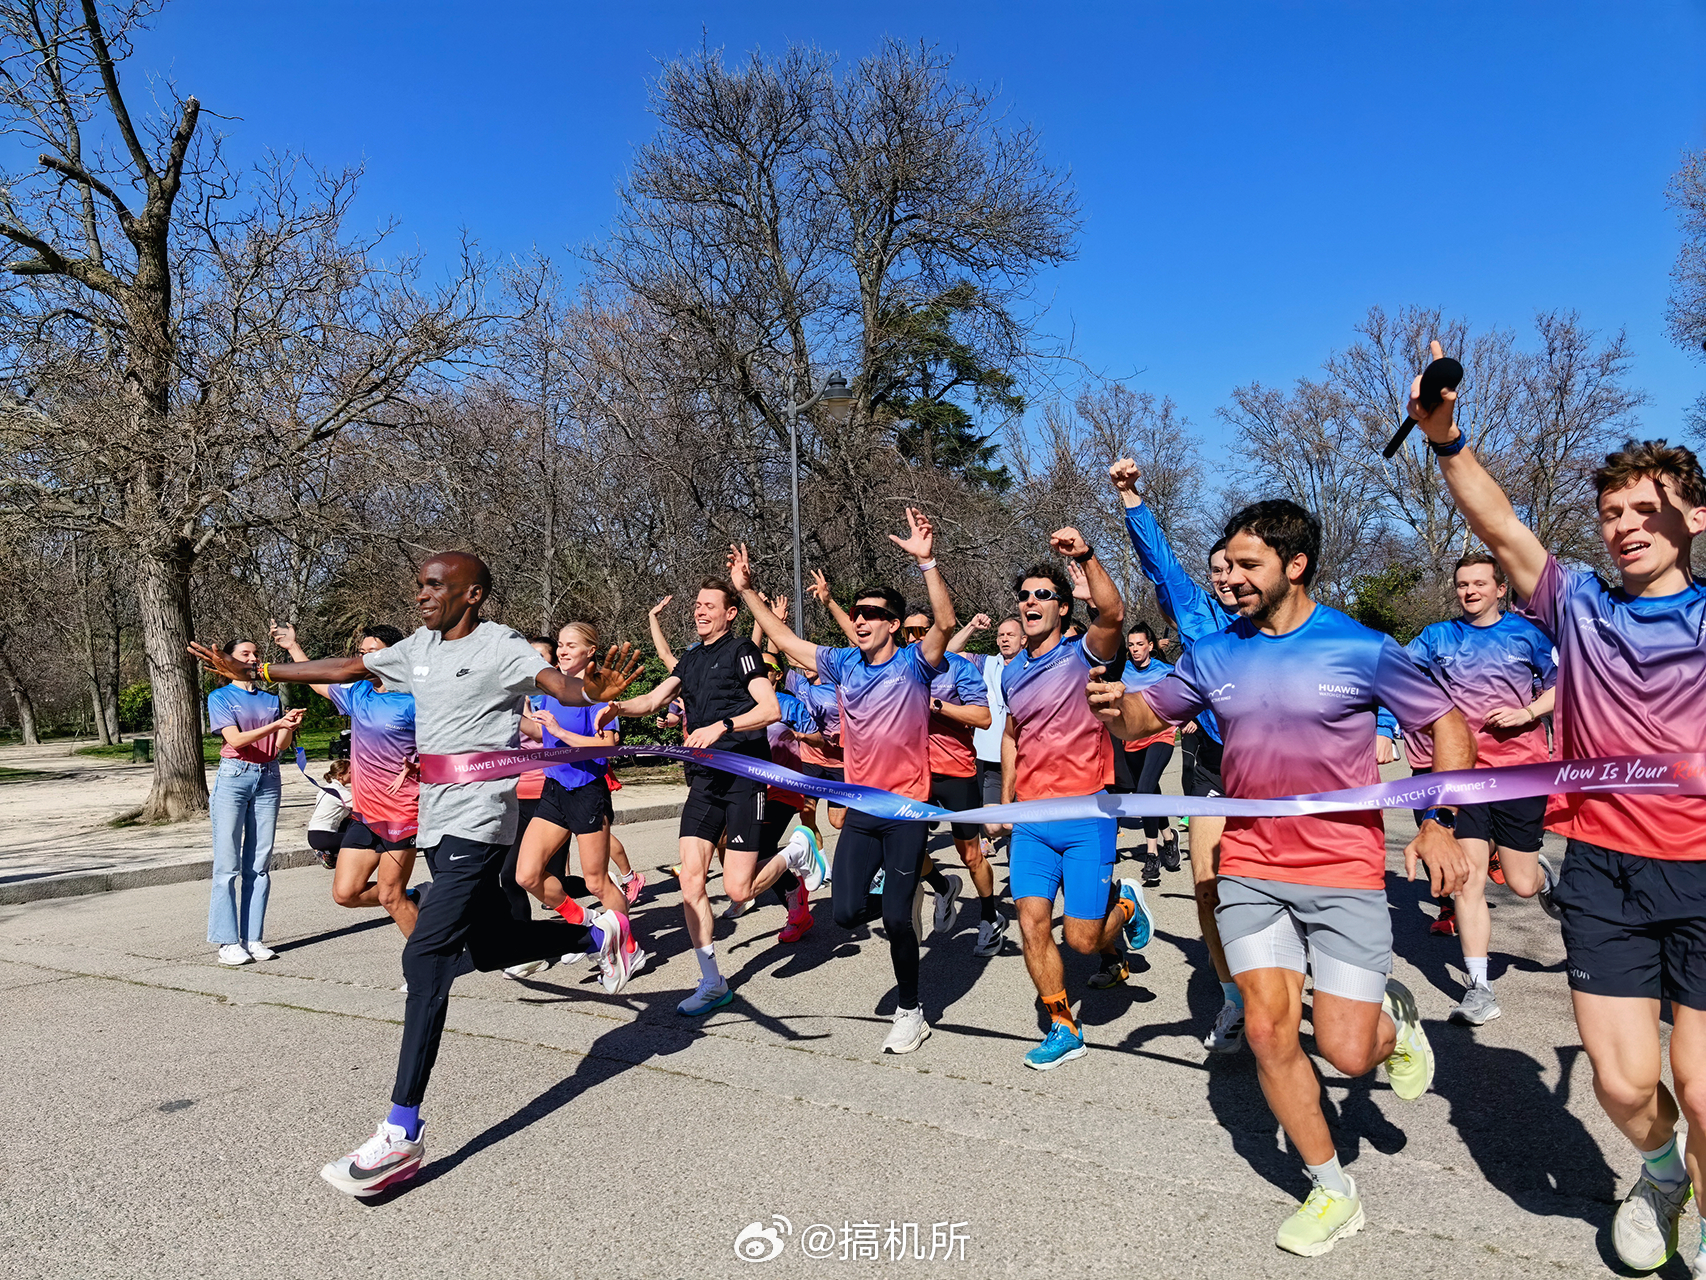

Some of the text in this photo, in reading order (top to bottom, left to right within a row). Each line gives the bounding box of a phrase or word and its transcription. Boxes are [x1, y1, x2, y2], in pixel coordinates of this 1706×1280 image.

[1318, 684, 1359, 695] HUAWEI
[454, 760, 495, 773] HUAWEI
[497, 754, 530, 767] WATCH
[531, 751, 542, 760] GT
[544, 748, 572, 758] Runner
[663, 746, 690, 754] Your
[691, 749, 714, 760] Run
[748, 766, 783, 783] HUAWEI
[786, 779, 815, 791] WATCH
[828, 788, 855, 799] Runner
[857, 793, 863, 801] 2
[1554, 763, 1596, 785] Now
[1599, 762, 1619, 781] Is
[1624, 758, 1668, 783] Your
[1383, 789, 1426, 806] WATCH
[1427, 784, 1442, 796] GT
[1445, 780, 1486, 793] Runner
[1488, 778, 1497, 788] 2
[894, 803, 924, 819] Now
